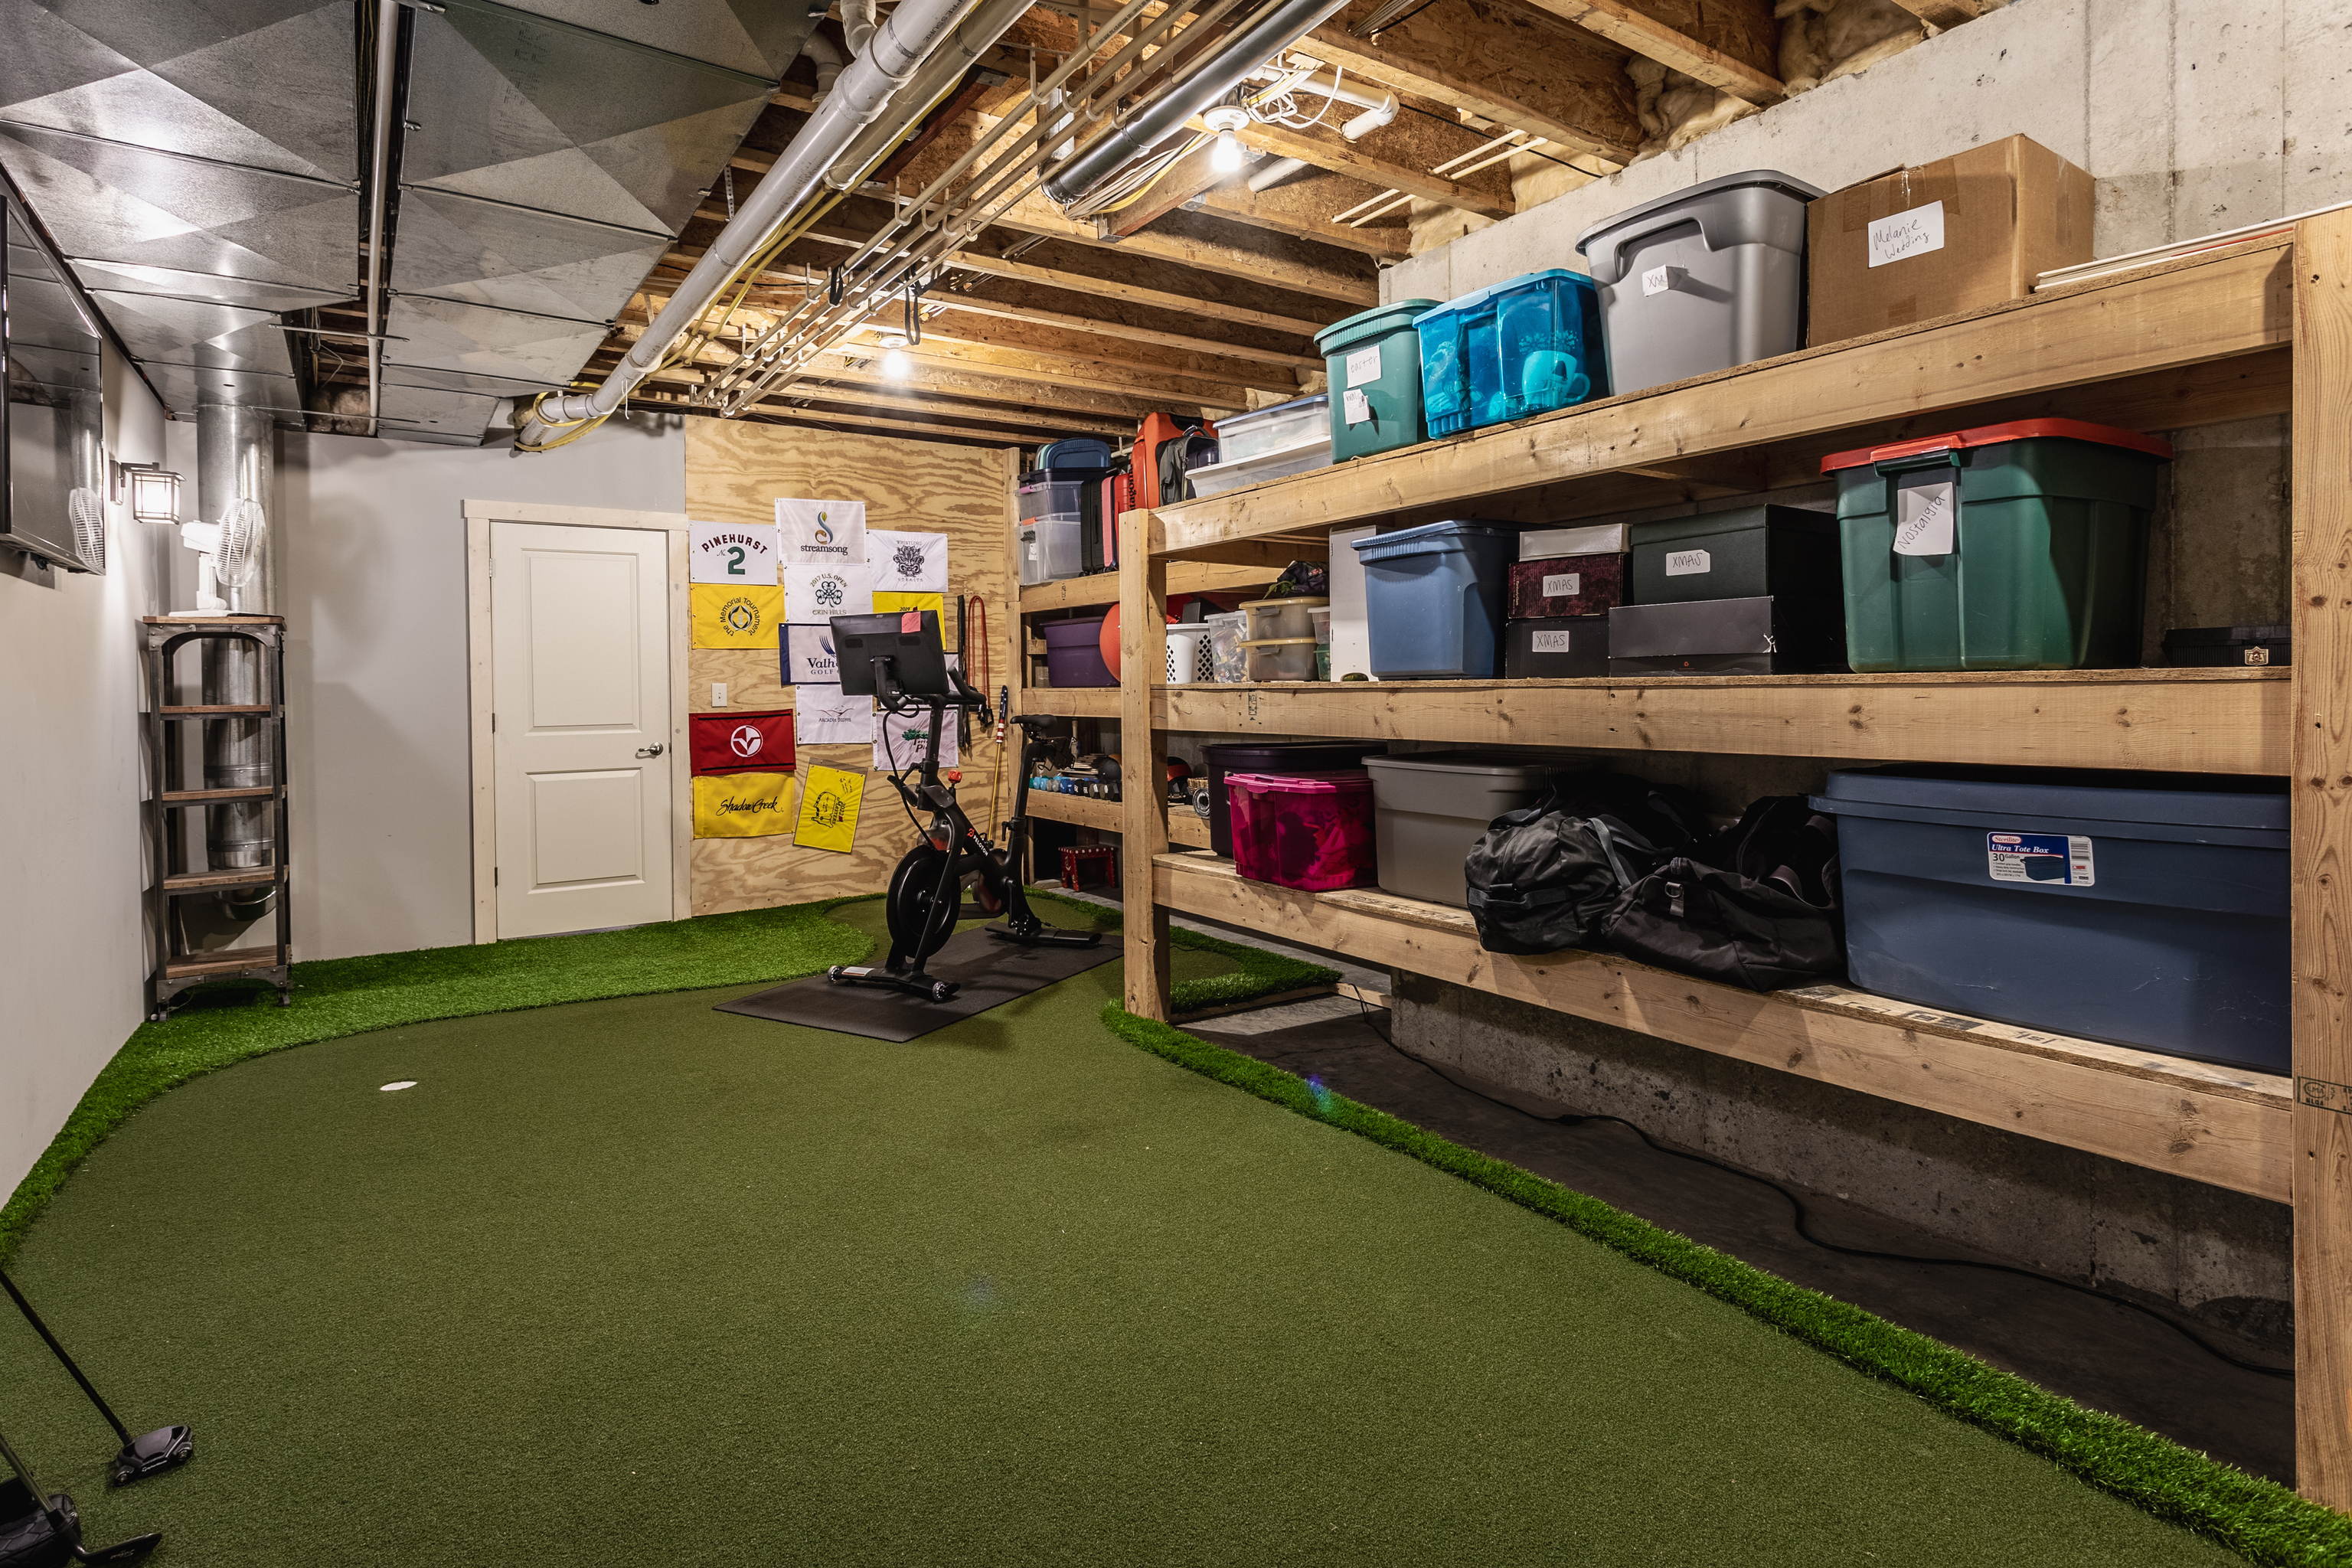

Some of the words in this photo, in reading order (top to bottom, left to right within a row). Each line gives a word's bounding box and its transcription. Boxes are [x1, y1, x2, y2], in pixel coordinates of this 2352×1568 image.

[1873, 219, 1922, 251] Melanie
[1885, 232, 1929, 260] Wedding
[1351, 355, 1378, 373] easter
[701, 534, 768, 554] PINEHURST
[800, 544, 848, 556] streamsong
[727, 546, 746, 575] 2
[1672, 552, 1704, 568] XMAS
[809, 575, 821, 588] 2017
[833, 574, 848, 588] OPEN
[1547, 579, 1573, 595] XMAS
[720, 596, 741, 623] Memorial
[743, 597, 760, 636] Tournament
[723, 625, 735, 637] the
[1537, 634, 1566, 649] XMAS
[806, 658, 838, 668] Valh
[912, 737, 927, 746] Torr
[716, 795, 753, 817] Shadow
[752, 795, 782, 813] Creek
[973, 835, 988, 857] PELOTON
[1992, 853, 2005, 862] 30
